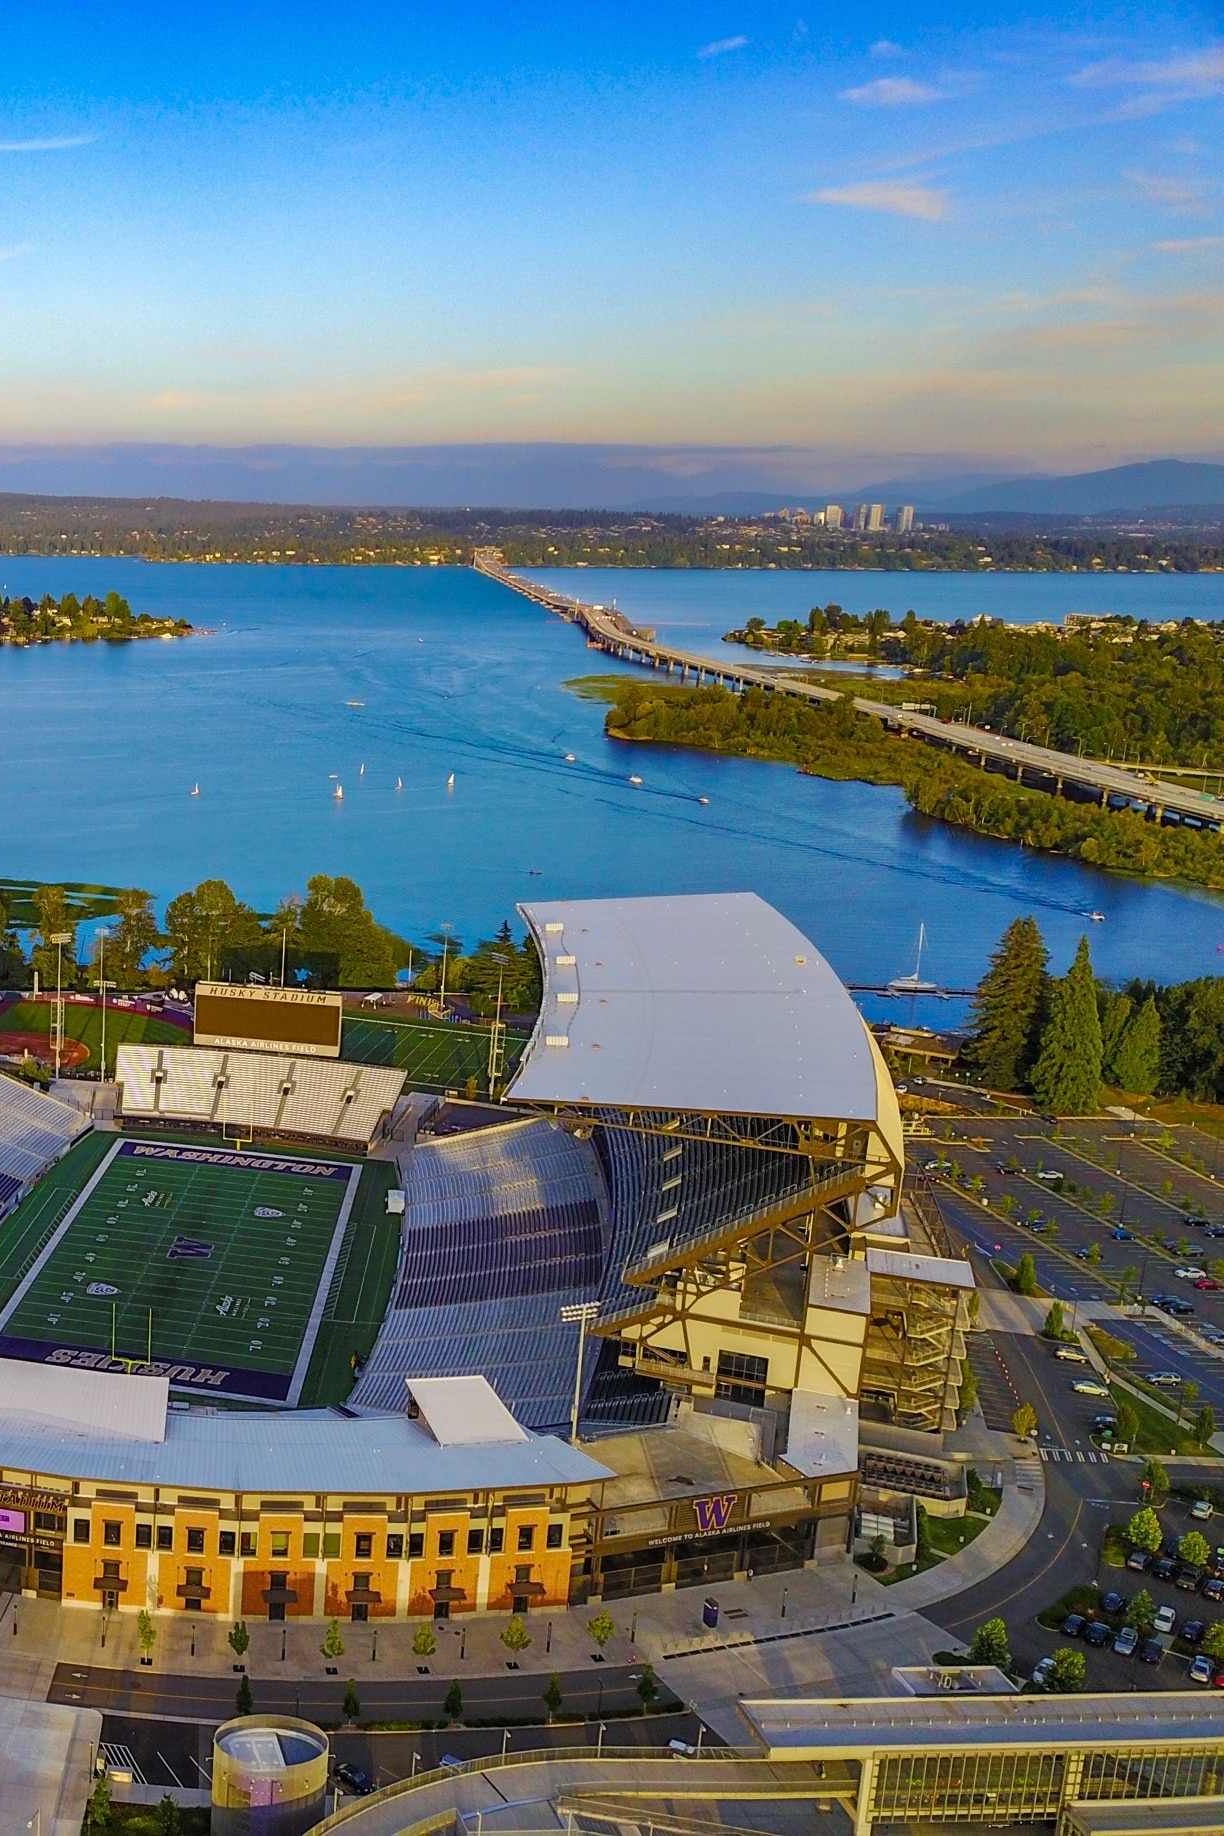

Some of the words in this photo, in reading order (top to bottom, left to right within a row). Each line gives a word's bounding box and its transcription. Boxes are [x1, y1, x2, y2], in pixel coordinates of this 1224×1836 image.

[210, 987, 256, 997] HUSKY
[263, 992, 327, 1003] STADIUM
[214, 1038, 248, 1047] ALASKA
[251, 1041, 290, 1051] AIRLINES
[292, 1045, 317, 1053] FIELD
[133, 1145, 338, 1176] WASHINGTON
[167, 1236, 215, 1259] W
[44, 1348, 231, 1385] HUSKIES
[693, 1494, 737, 1531] W
[5, 1533, 34, 1544] AIRLINES
[36, 1538, 55, 1547] FIELD
[648, 1535, 682, 1546] WELCOME
[694, 1529, 721, 1539] ALASKA
[722, 1524, 751, 1535] AIRLINES
[753, 1521, 770, 1529] FIELD
